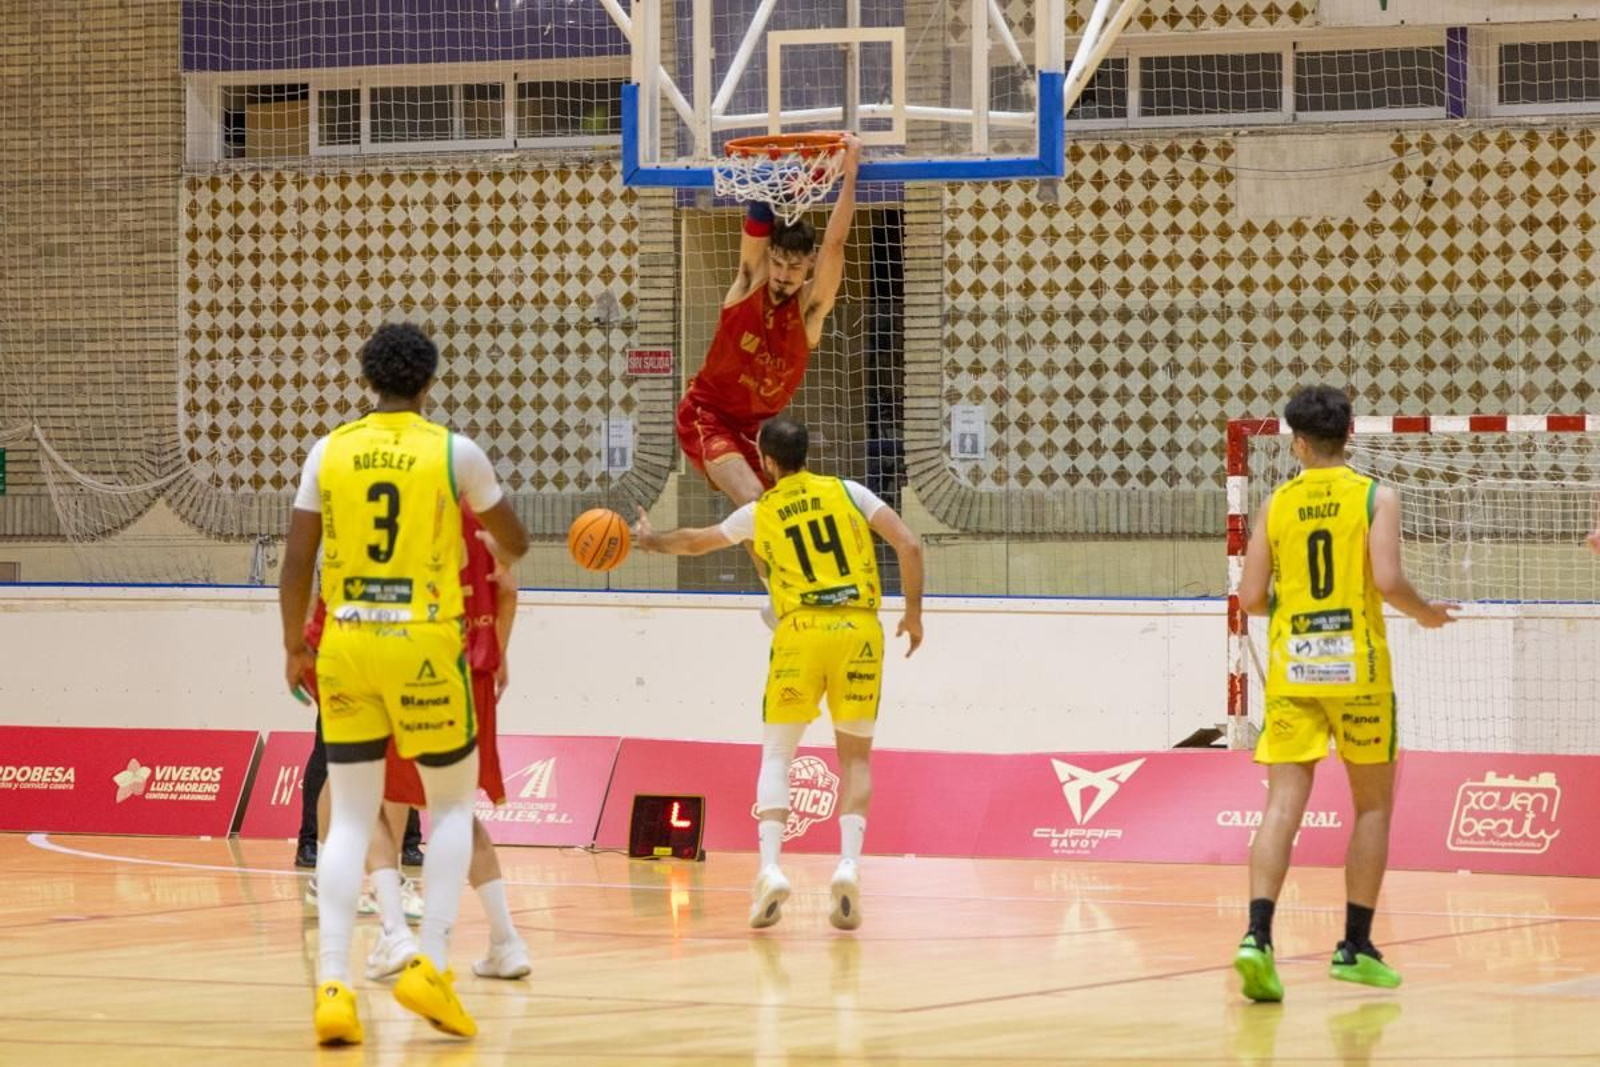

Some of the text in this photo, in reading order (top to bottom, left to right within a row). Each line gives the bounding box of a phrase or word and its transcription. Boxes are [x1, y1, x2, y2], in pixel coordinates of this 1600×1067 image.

[353, 448, 416, 472] ROÉSLEY
[777, 499, 809, 521] DAVID
[1298, 502, 1341, 521] OROZCO
[367, 481, 400, 565] 3
[784, 514, 851, 583] 14
[1307, 528, 1335, 600] 0
[155, 765, 224, 782] VIVEROS
[149, 781, 220, 793] LUIS MORENO
[474, 809, 541, 825] RALES,
[1216, 810, 1342, 828] CAJA RAL
[1033, 828, 1123, 839] CUPRA
[1050, 839, 1100, 849] SAVOY
